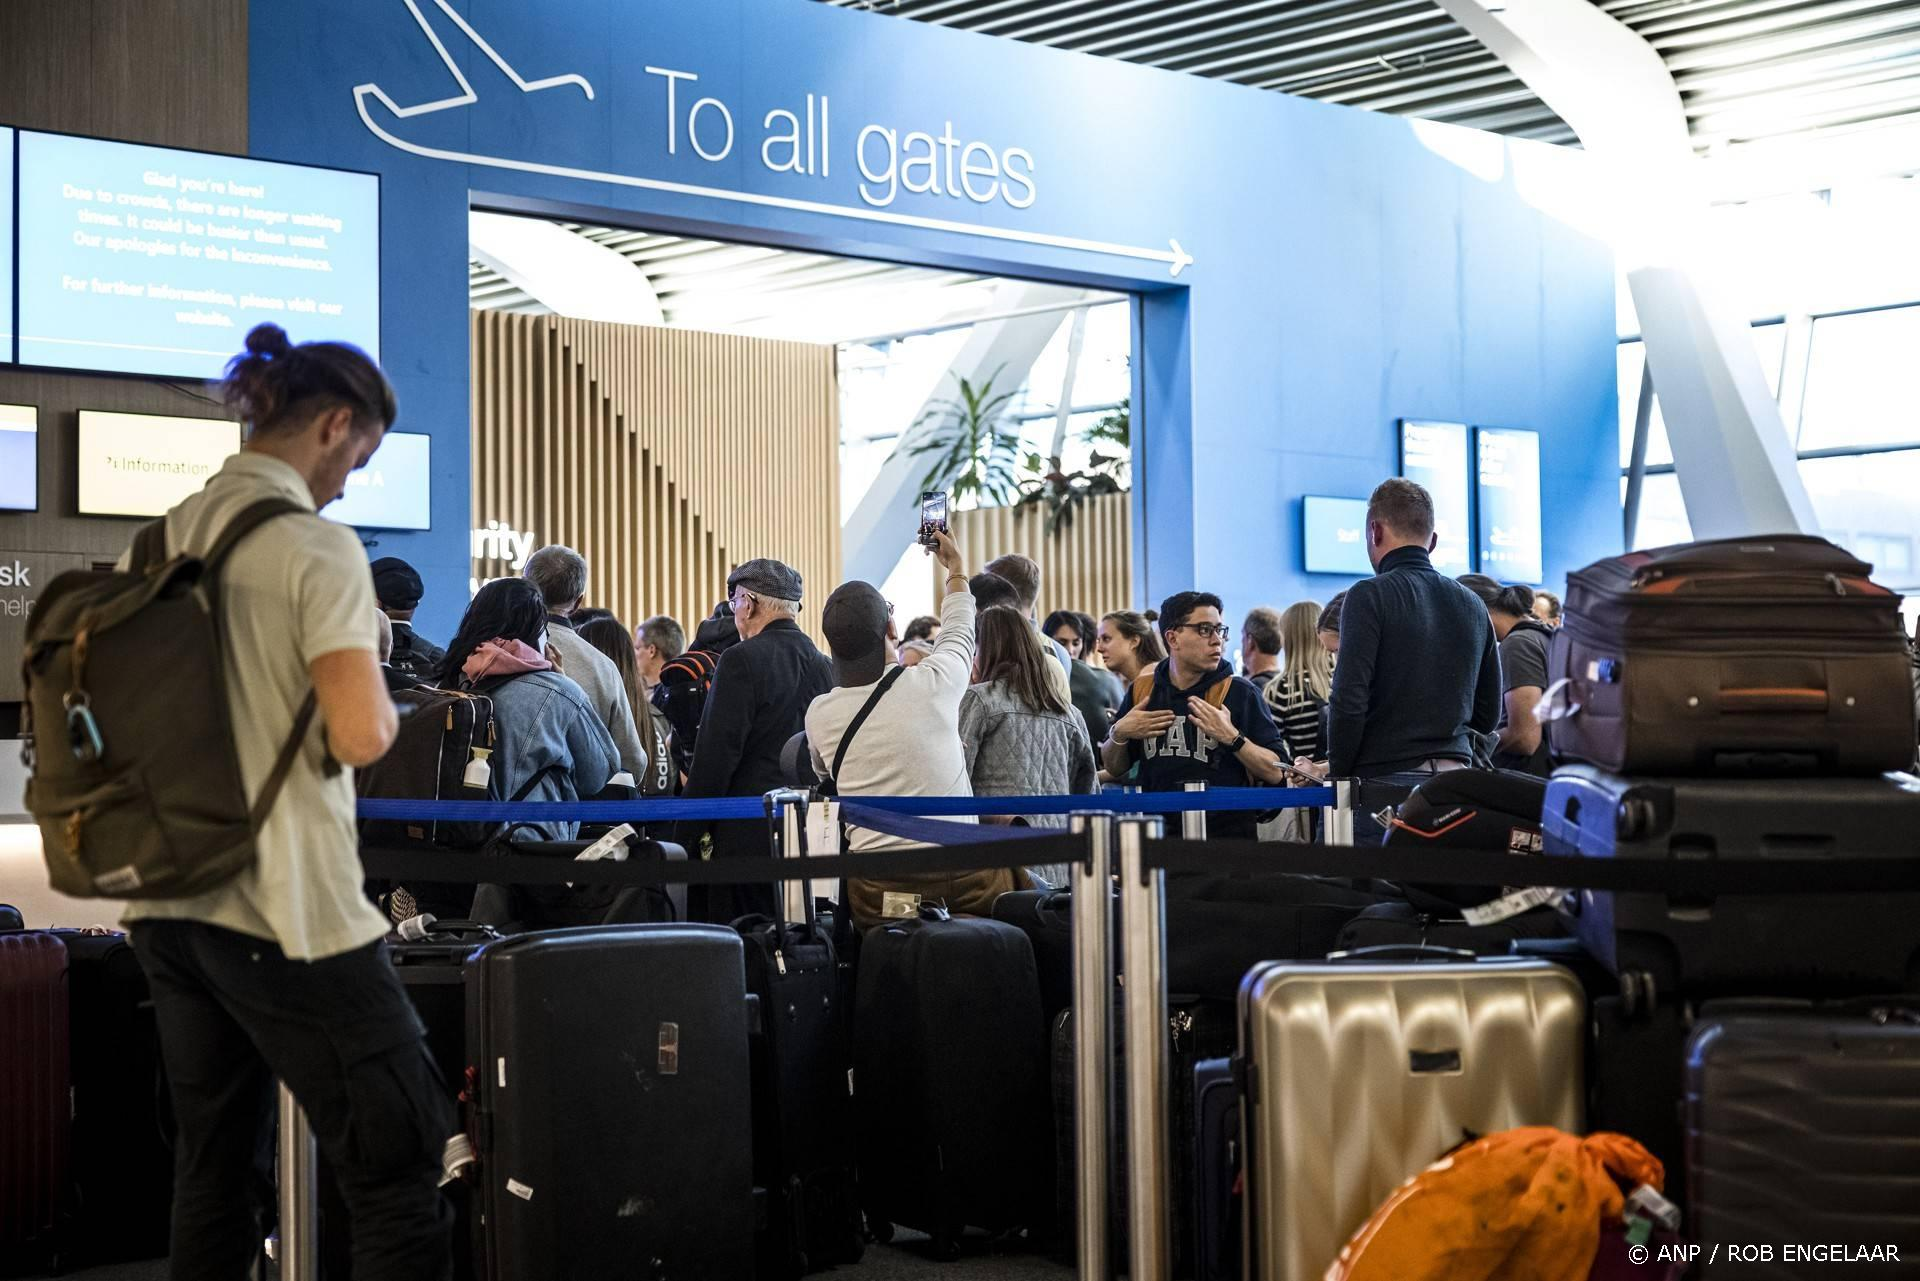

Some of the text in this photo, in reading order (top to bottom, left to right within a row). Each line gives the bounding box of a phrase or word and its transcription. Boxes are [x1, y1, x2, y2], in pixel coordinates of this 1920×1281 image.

[645, 65, 1037, 209] To all gates
[143, 170, 177, 188] Glad
[228, 180, 264, 199] here!
[63, 183, 342, 233] Due to crowds, there are longer waiting
[73, 230, 102, 248] Our
[105, 236, 177, 257] apologies
[180, 240, 202, 257] for
[204, 244, 228, 261] the
[142, 217, 182, 233] could
[186, 219, 204, 236] be
[207, 222, 251, 241] busier
[254, 227, 286, 245] than
[288, 234, 329, 250] usual.
[62, 275, 88, 292] For
[91, 276, 145, 297] further
[240, 292, 285, 310] please
[287, 296, 316, 313] visit
[319, 302, 343, 316] our
[122, 457, 209, 475] Information
[469, 519, 535, 570] rity
